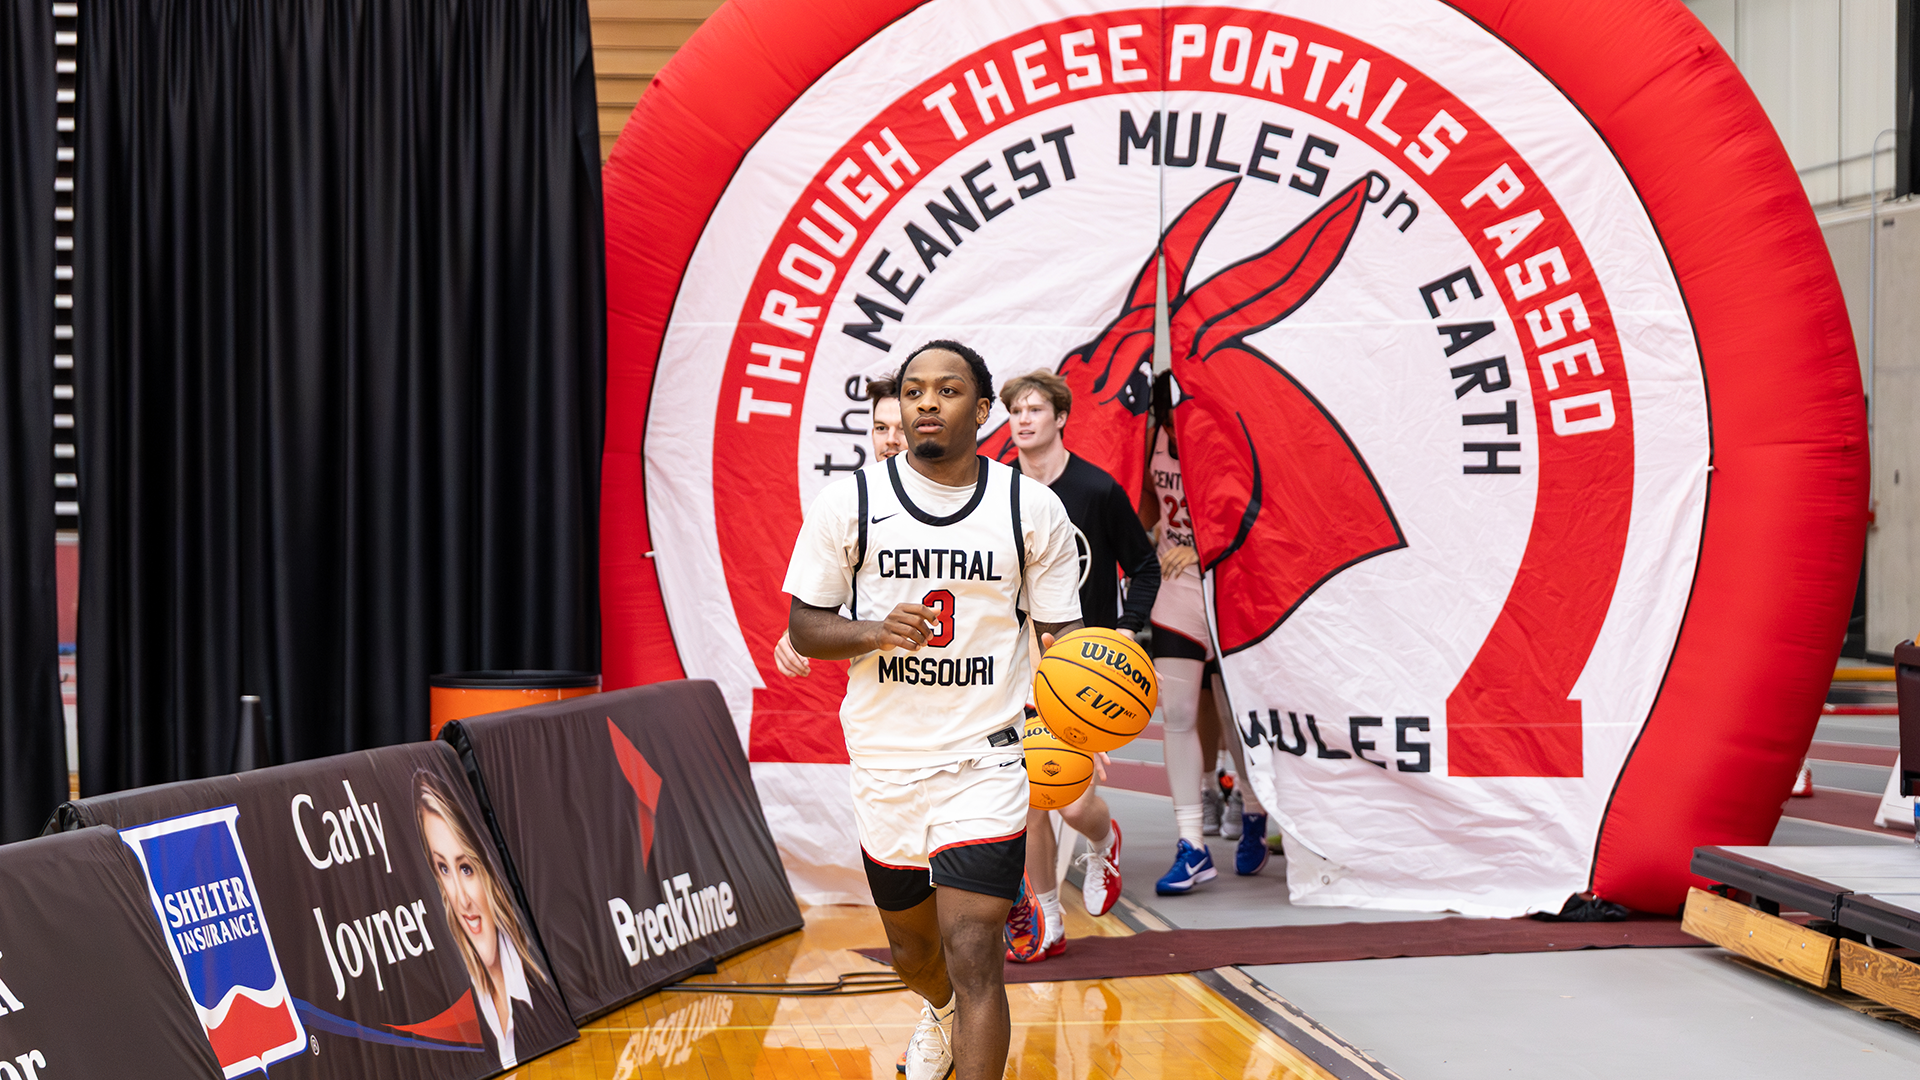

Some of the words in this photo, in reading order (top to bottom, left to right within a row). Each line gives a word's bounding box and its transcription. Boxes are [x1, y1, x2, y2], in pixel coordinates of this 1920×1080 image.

[1118, 110, 1340, 197] MULES
[736, 126, 921, 423] THROUGH
[922, 23, 1148, 141] THESE
[1169, 23, 1469, 175] PORTALS
[1460, 162, 1616, 436] PASSED
[842, 124, 1076, 352] MEANEST
[1365, 170, 1420, 233] on
[1418, 265, 1521, 475] EARTH
[814, 373, 873, 476] the
[877, 548, 1002, 581] CENTRAL
[922, 588, 956, 649] 3
[878, 655, 994, 687] MISSOURI
[1080, 641, 1152, 697] Wilson
[1236, 708, 1430, 772] MULES
[291, 779, 392, 874] Carly
[164, 876, 251, 929] SHELTER
[176, 912, 259, 956] INSURANCE
[607, 872, 738, 968] BreakTime
[312, 899, 435, 1001] Joyner
